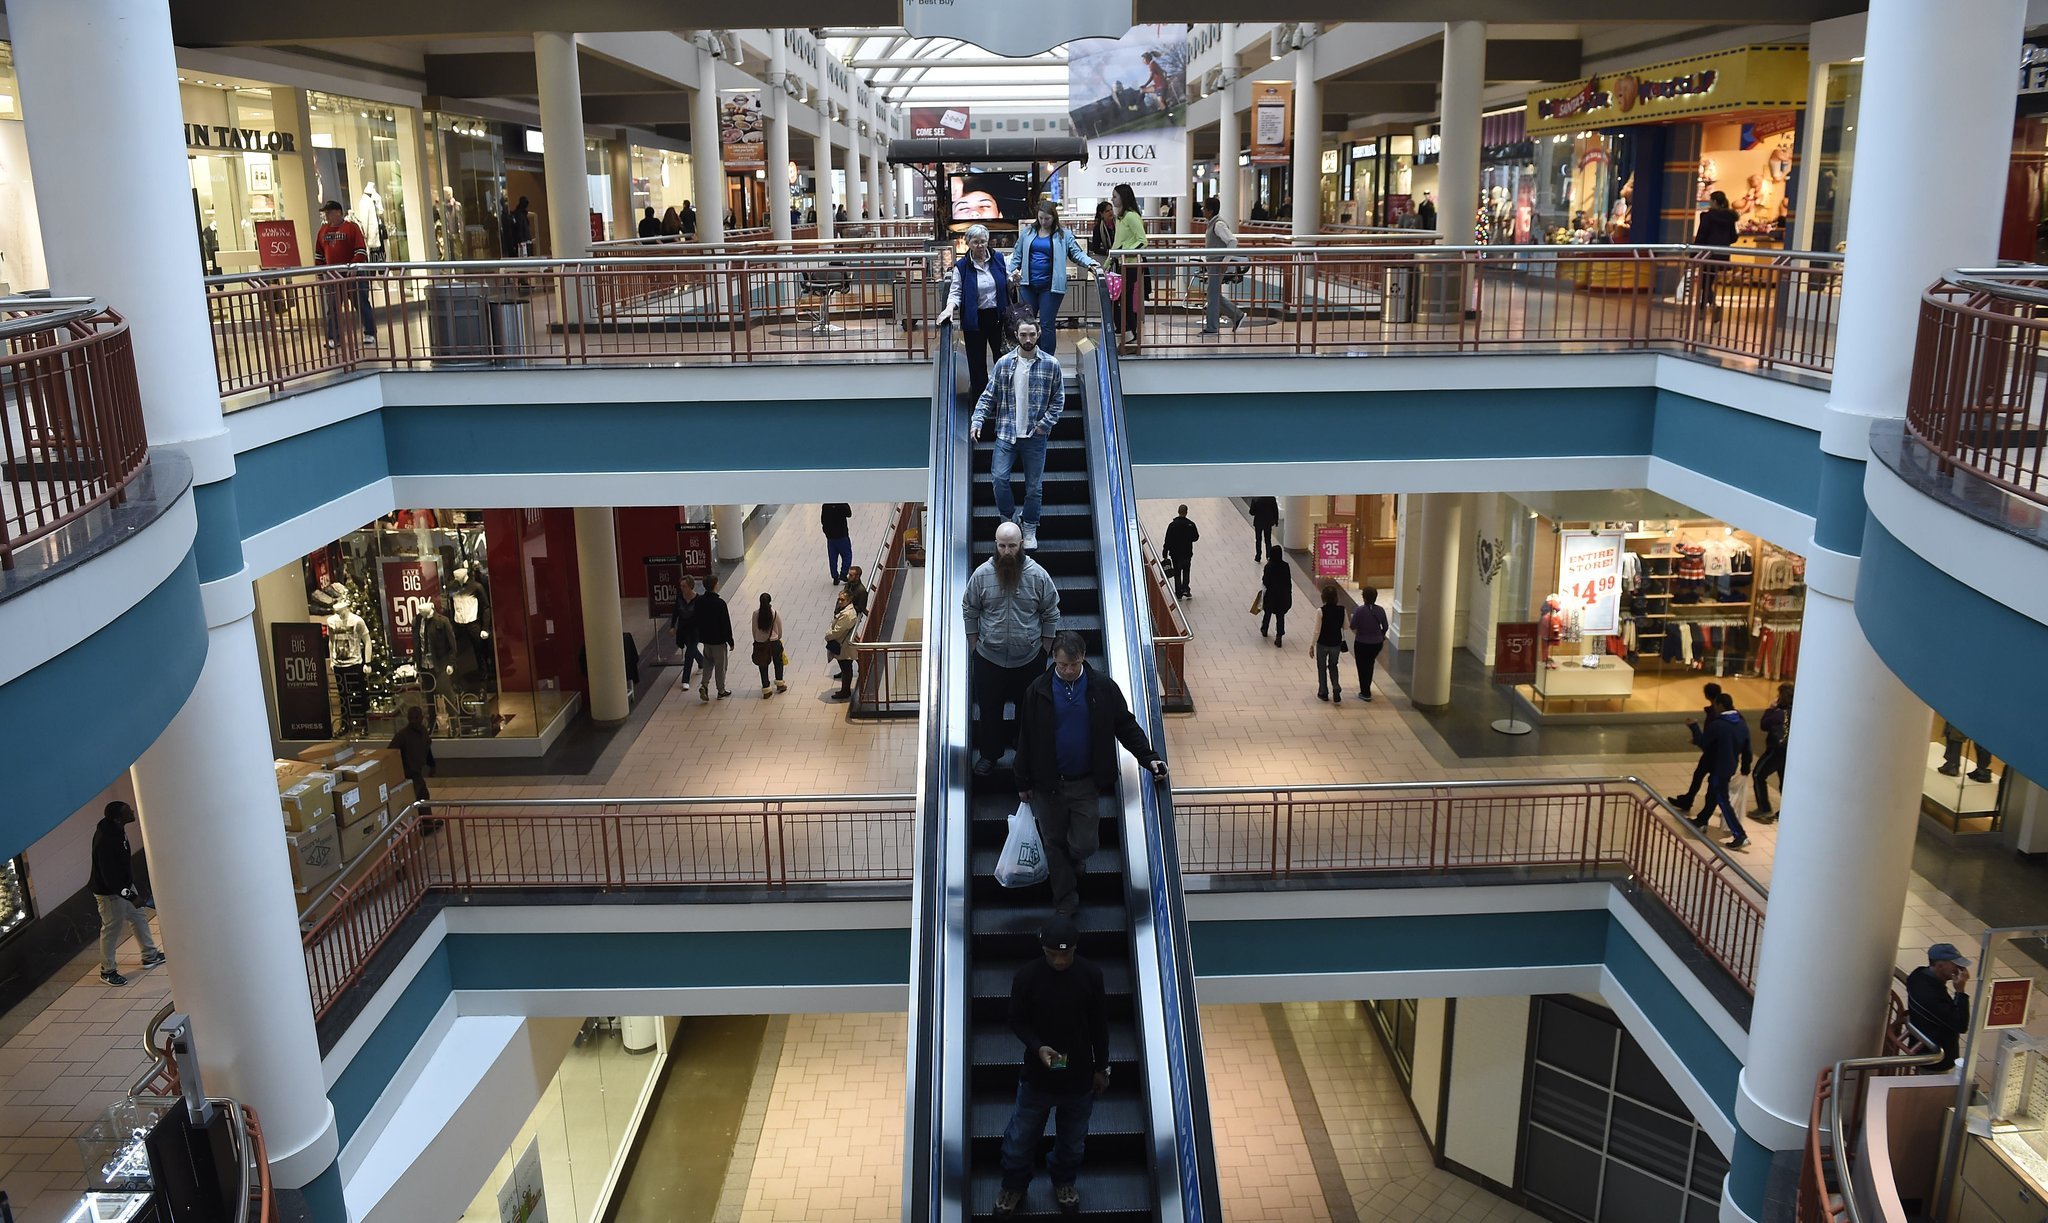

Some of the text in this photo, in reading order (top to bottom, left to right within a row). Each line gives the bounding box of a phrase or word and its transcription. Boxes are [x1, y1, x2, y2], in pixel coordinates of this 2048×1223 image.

[213, 126, 295, 152] TAYLOR
[915, 127, 946, 137] COME SEE
[1097, 144, 1157, 161] UTICA
[1105, 166, 1149, 174] COLLEGE
[1569, 548, 1615, 565] ENTIRE
[402, 568, 420, 576] SAVE
[1568, 558, 1614, 575] STORE!
[402, 575, 422, 592] BIG
[291, 639, 306, 653] BIG
[284, 656, 317, 682] 50%
[306, 672, 317, 681] OFF
[291, 722, 323, 730] EXPRESS
